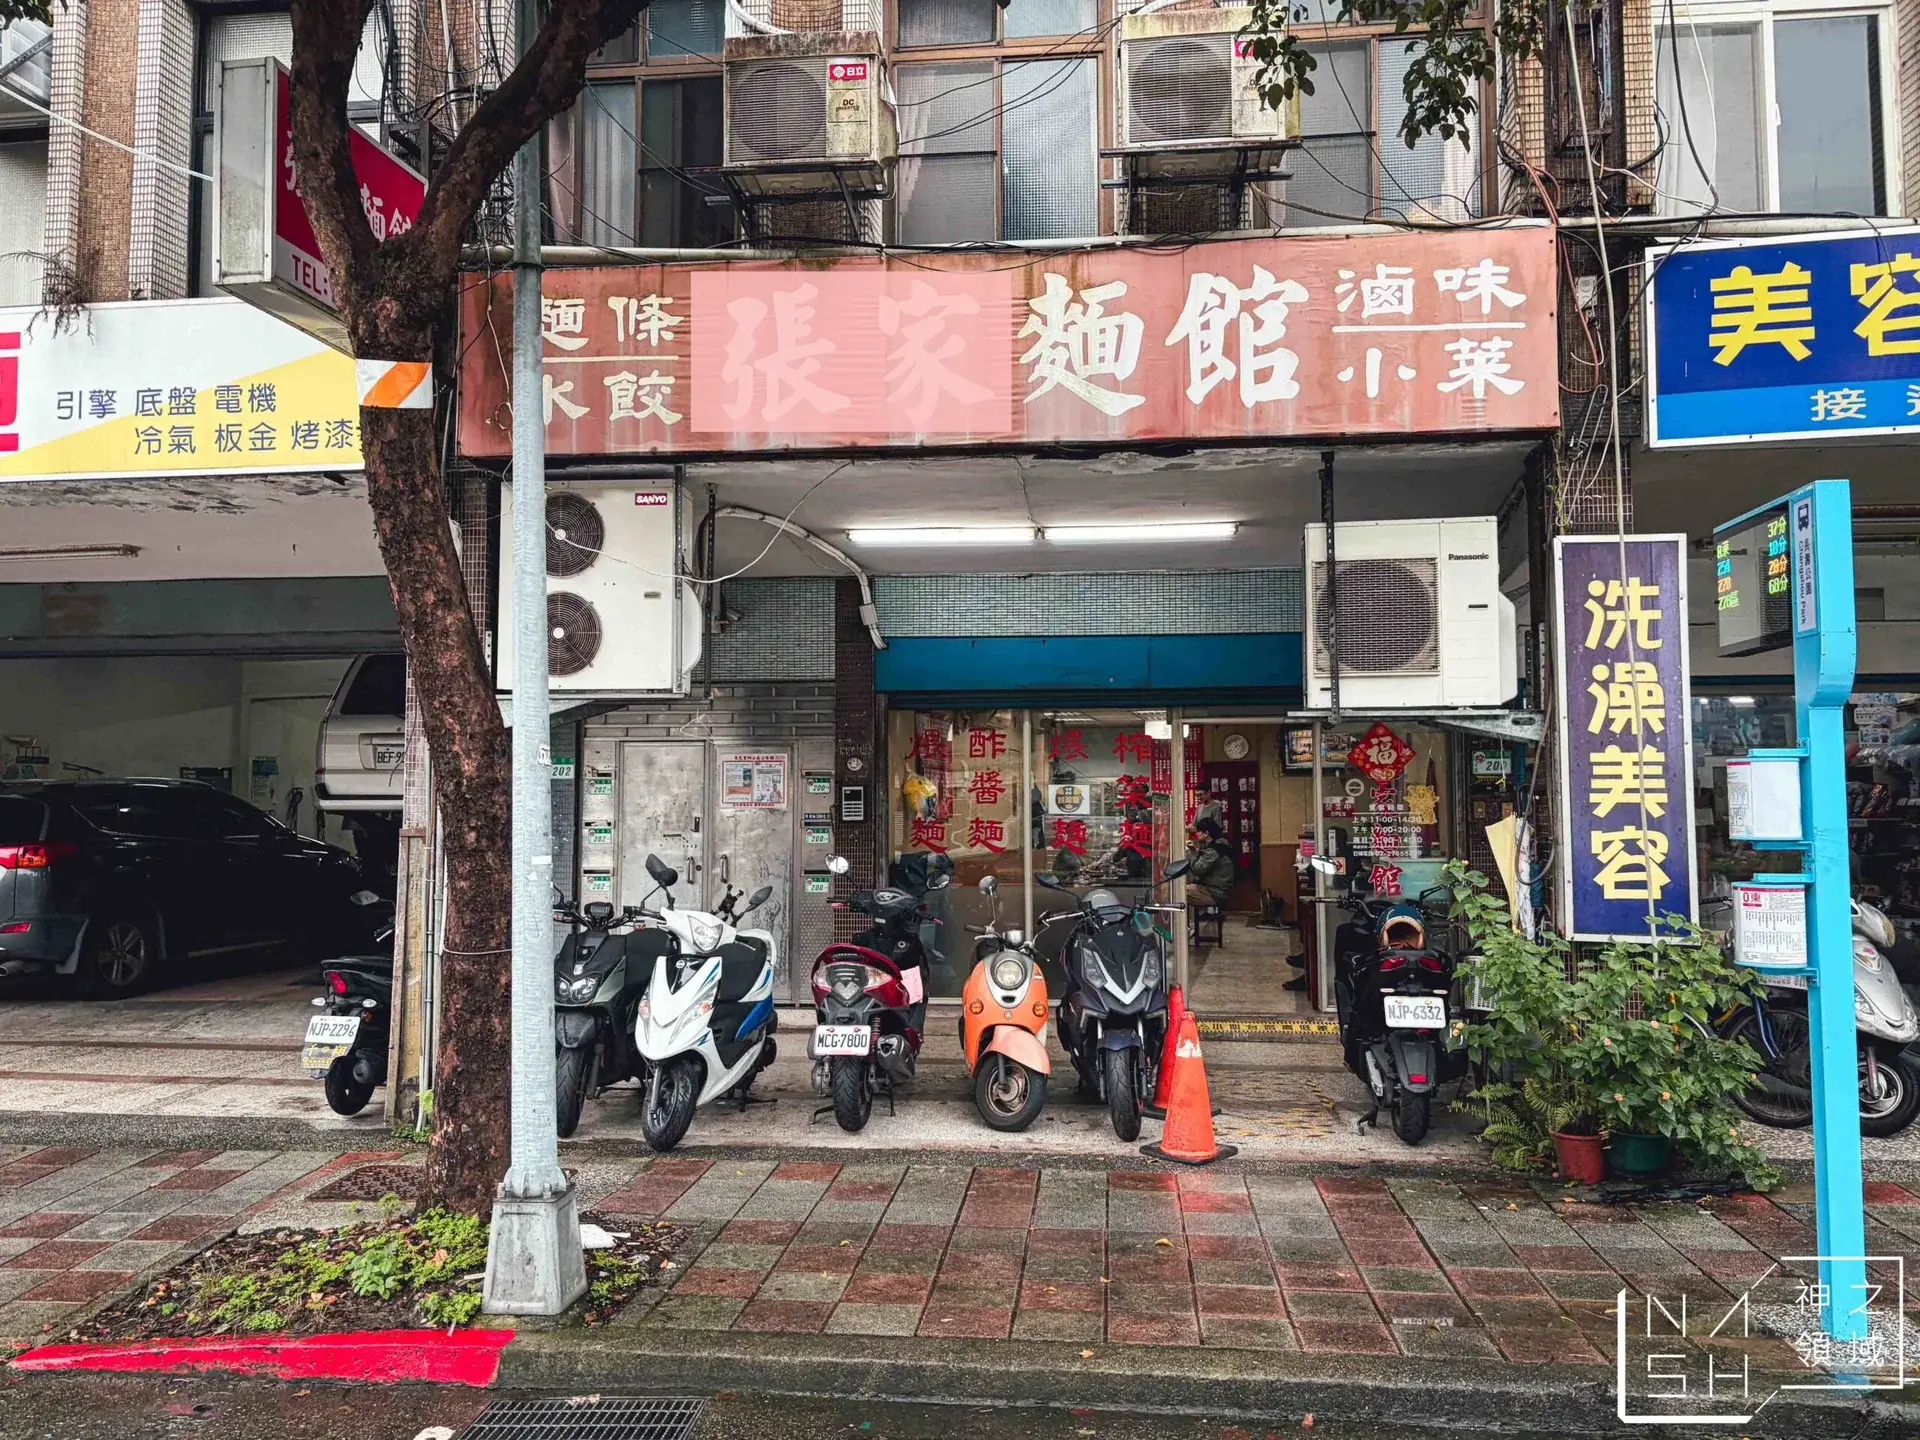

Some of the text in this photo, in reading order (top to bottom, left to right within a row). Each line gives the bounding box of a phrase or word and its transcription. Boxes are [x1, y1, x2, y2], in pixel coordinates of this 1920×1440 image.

[846, 66, 865, 77] 日立
[842, 98, 855, 106] DC
[1333, 257, 1528, 317] 滷味
[720, 264, 1310, 427] 張家麵館
[1335, 335, 1526, 399] 小菜
[57, 383, 277, 420] 引擎 底盤 電機
[135, 418, 353, 456] 冷氣 板金 烤漆
[635, 494, 667, 504] SANYO
[1448, 553, 1490, 561] Panasonic
[1583, 576, 1672, 901] 洗澡美容
[1366, 736, 1398, 765] 福
[552, 766, 572, 777] 202
[1352, 816, 1368, 824] 上午
[1352, 826, 1368, 834] 下午
[1742, 891, 1762, 903] 0東
[1387, 1004, 1442, 1021] NJP-6332
[308, 1022, 357, 1037] NJP-2296
[817, 1033, 868, 1048] MCG-7800
